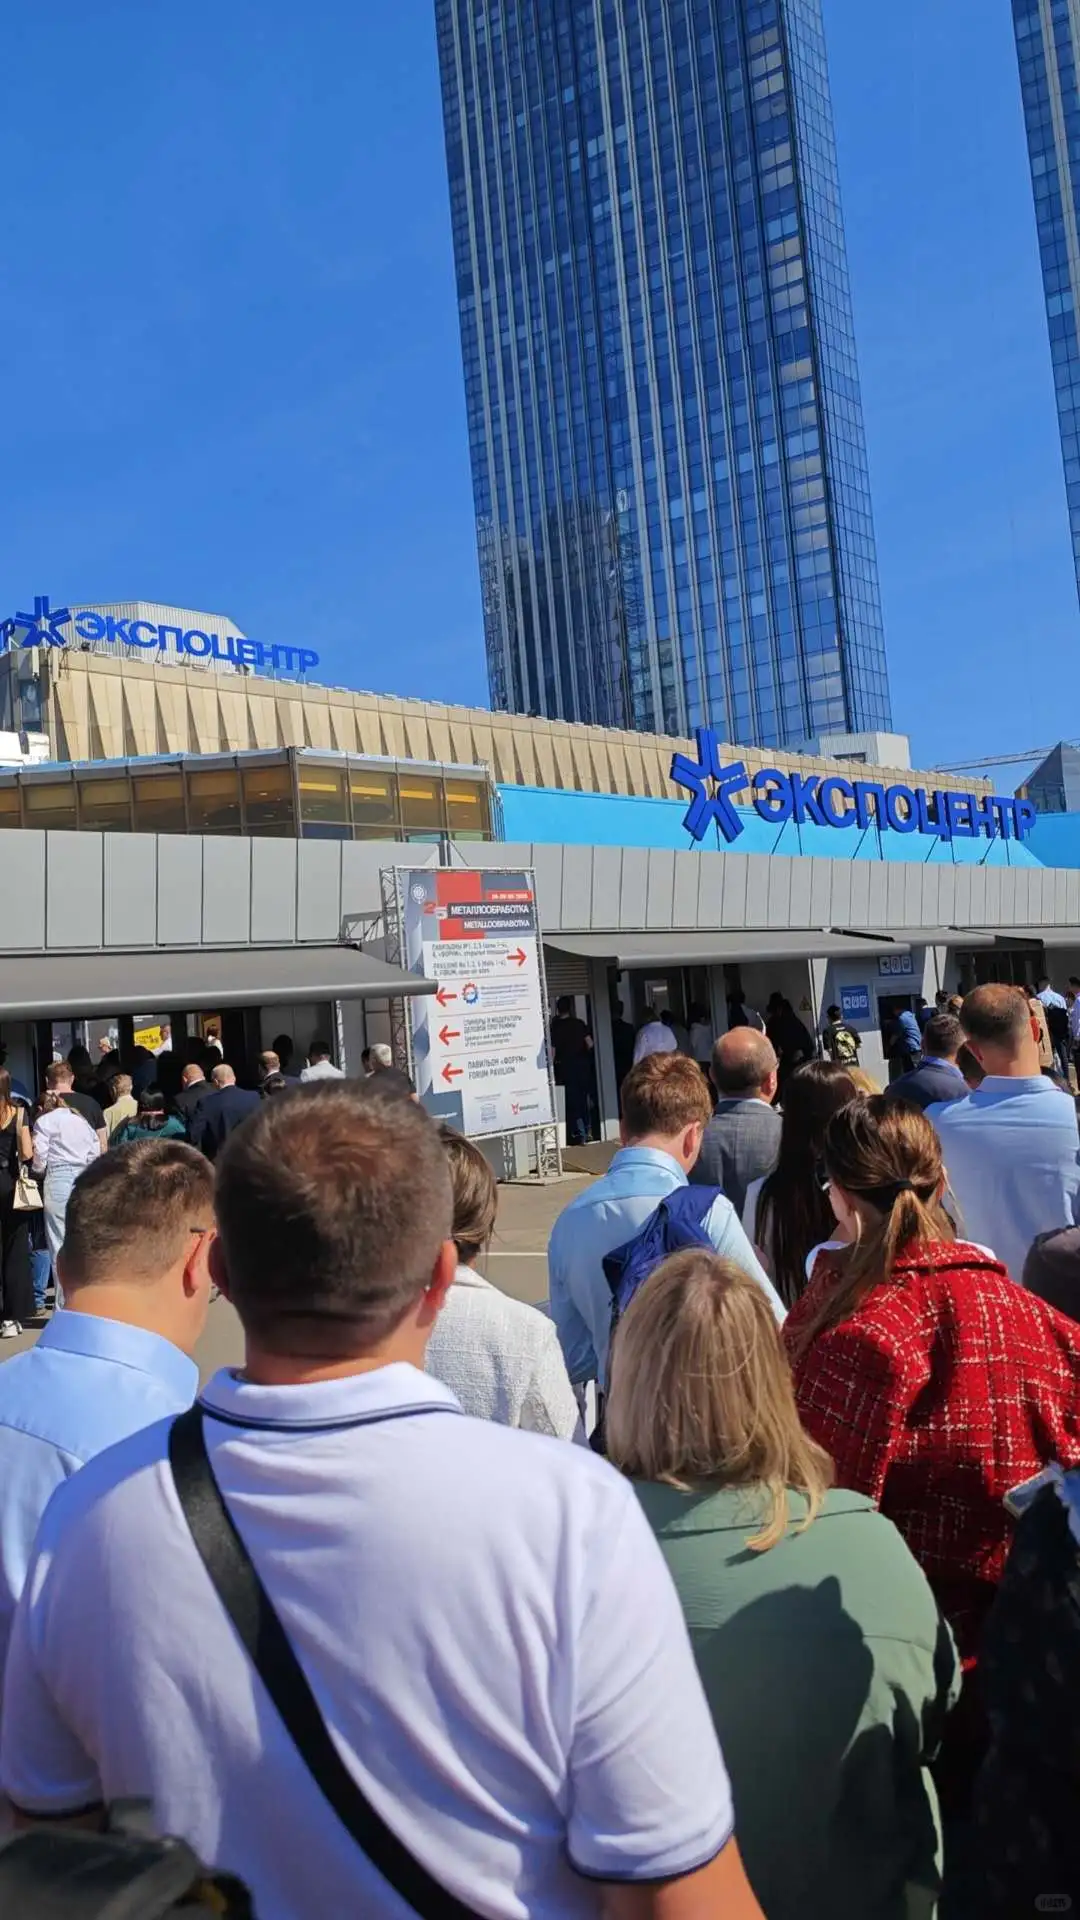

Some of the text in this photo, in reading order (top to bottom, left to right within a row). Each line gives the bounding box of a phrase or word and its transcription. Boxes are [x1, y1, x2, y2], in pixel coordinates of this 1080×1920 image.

[75, 611, 319, 673] ЭКСПОЦЕНТР
[752, 768, 1036, 841] ЭКСПОЦЕНТР
[450, 904, 530, 915] МЕТАЛЛООБРАБОТКА
[468, 1067, 516, 1079] FORUM PAVILION
